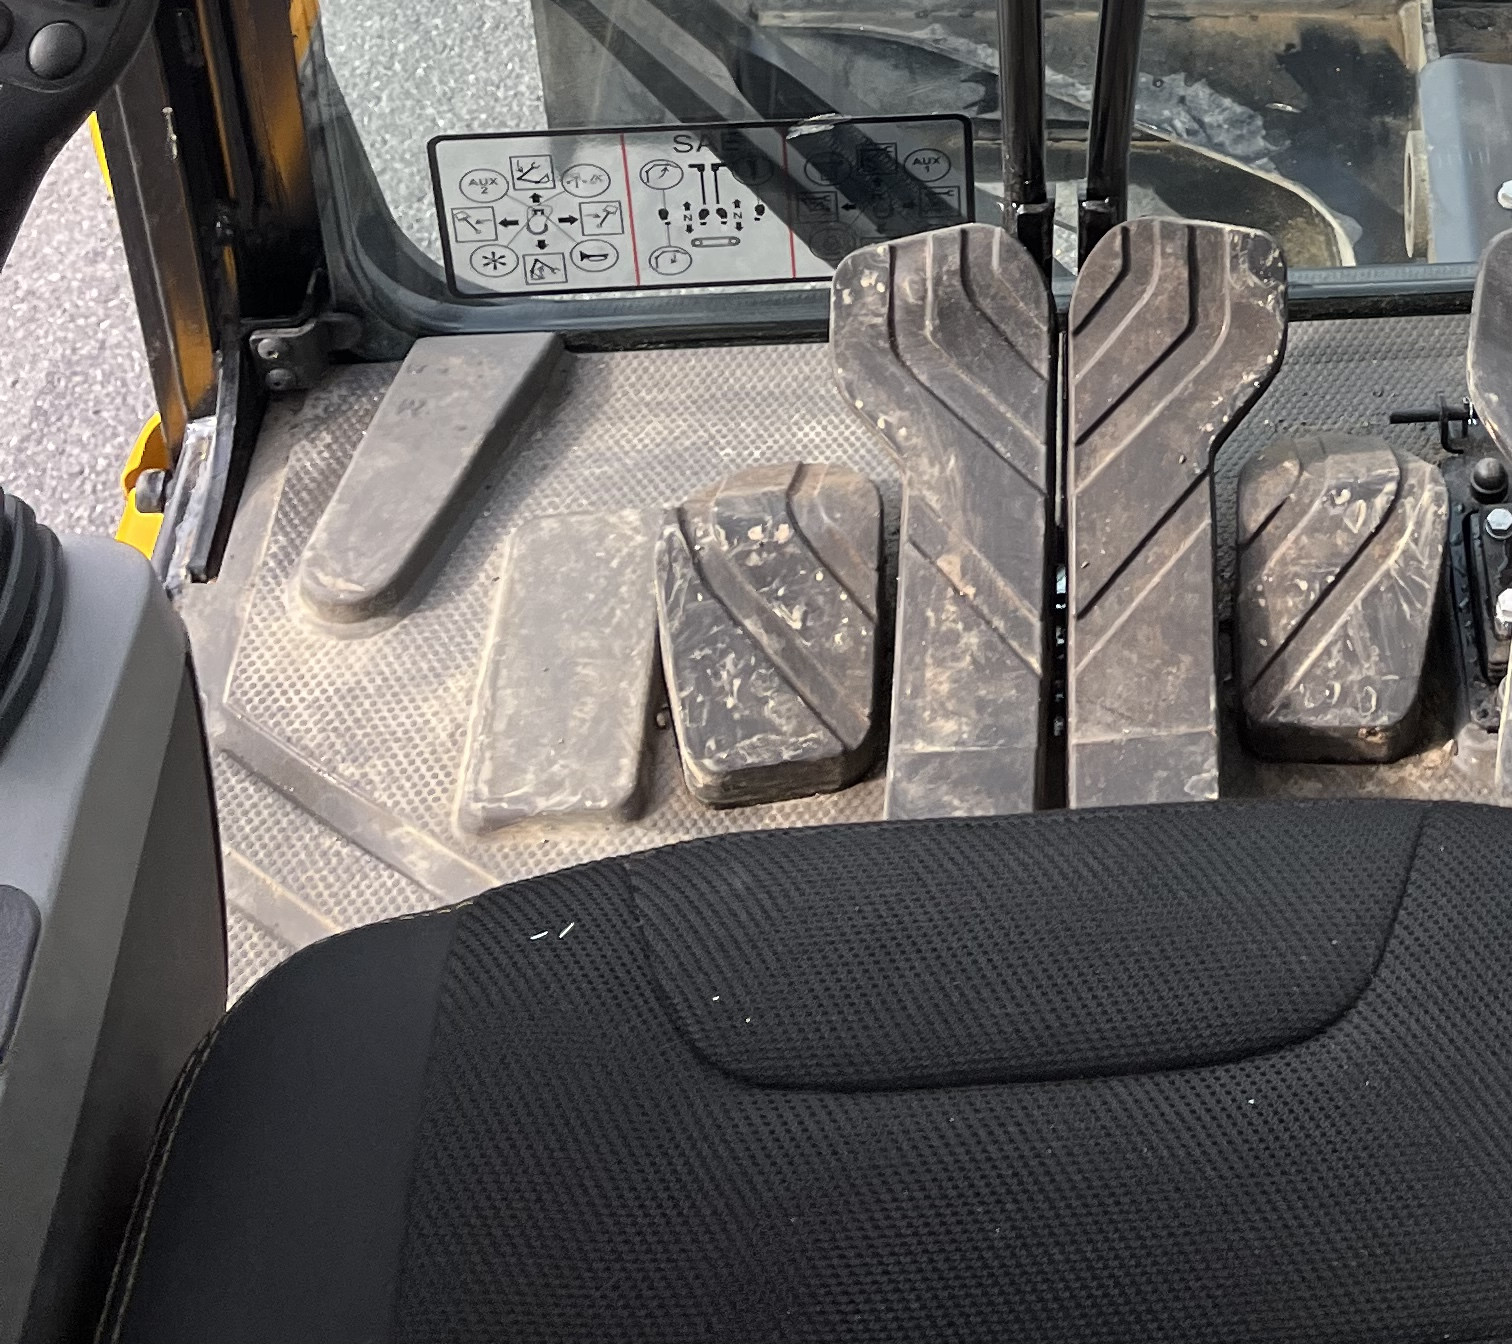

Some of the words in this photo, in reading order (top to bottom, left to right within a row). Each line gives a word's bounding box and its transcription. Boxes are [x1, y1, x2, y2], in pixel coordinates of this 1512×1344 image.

[912, 156, 942, 166] AUX
[467, 177, 499, 187] AUX
[480, 186, 489, 195] 2
